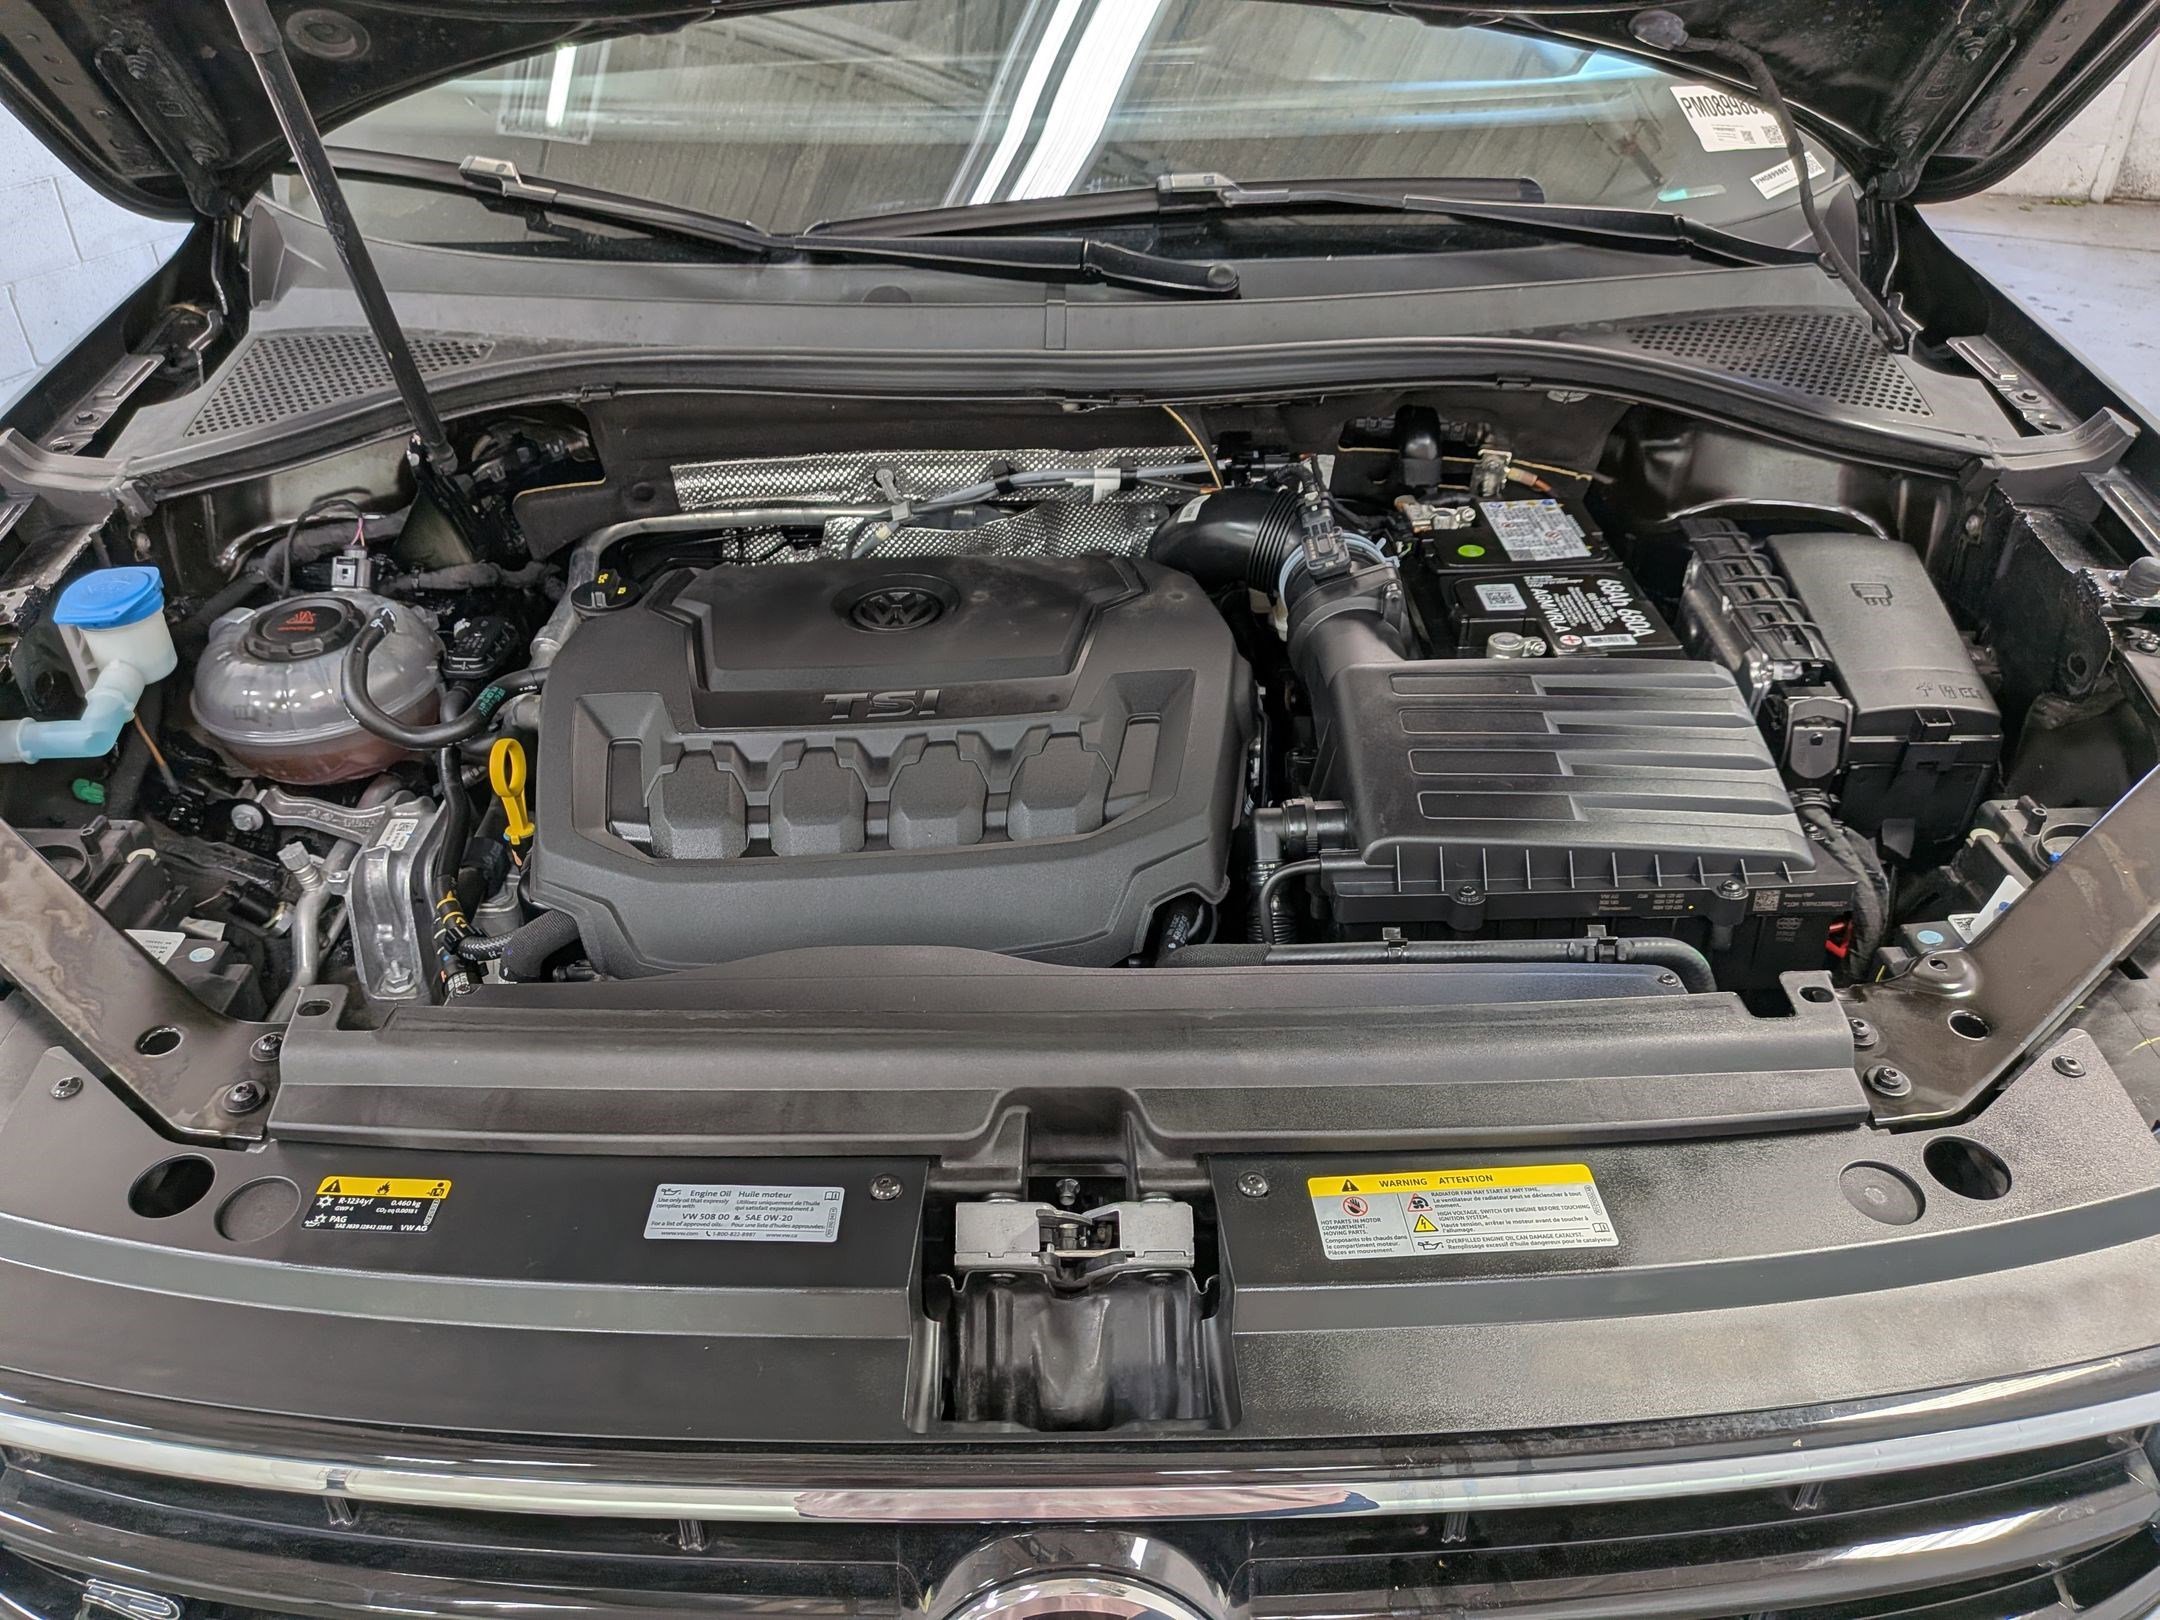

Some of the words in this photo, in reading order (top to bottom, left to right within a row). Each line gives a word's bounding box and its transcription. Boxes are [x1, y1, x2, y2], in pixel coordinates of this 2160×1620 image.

[1680, 95, 1766, 118] PM08998
[1596, 579, 1634, 607] 68Ah
[1616, 608, 1656, 637] 680A
[822, 688, 943, 720] TSI
[1378, 1178, 1428, 1188] WARNING
[1439, 1174, 1494, 1184] ATTENTION
[690, 1190, 718, 1198] Engine
[338, 1197, 375, 1207] R-1234yf
[1333, 1242, 1376, 1250] compartiment
